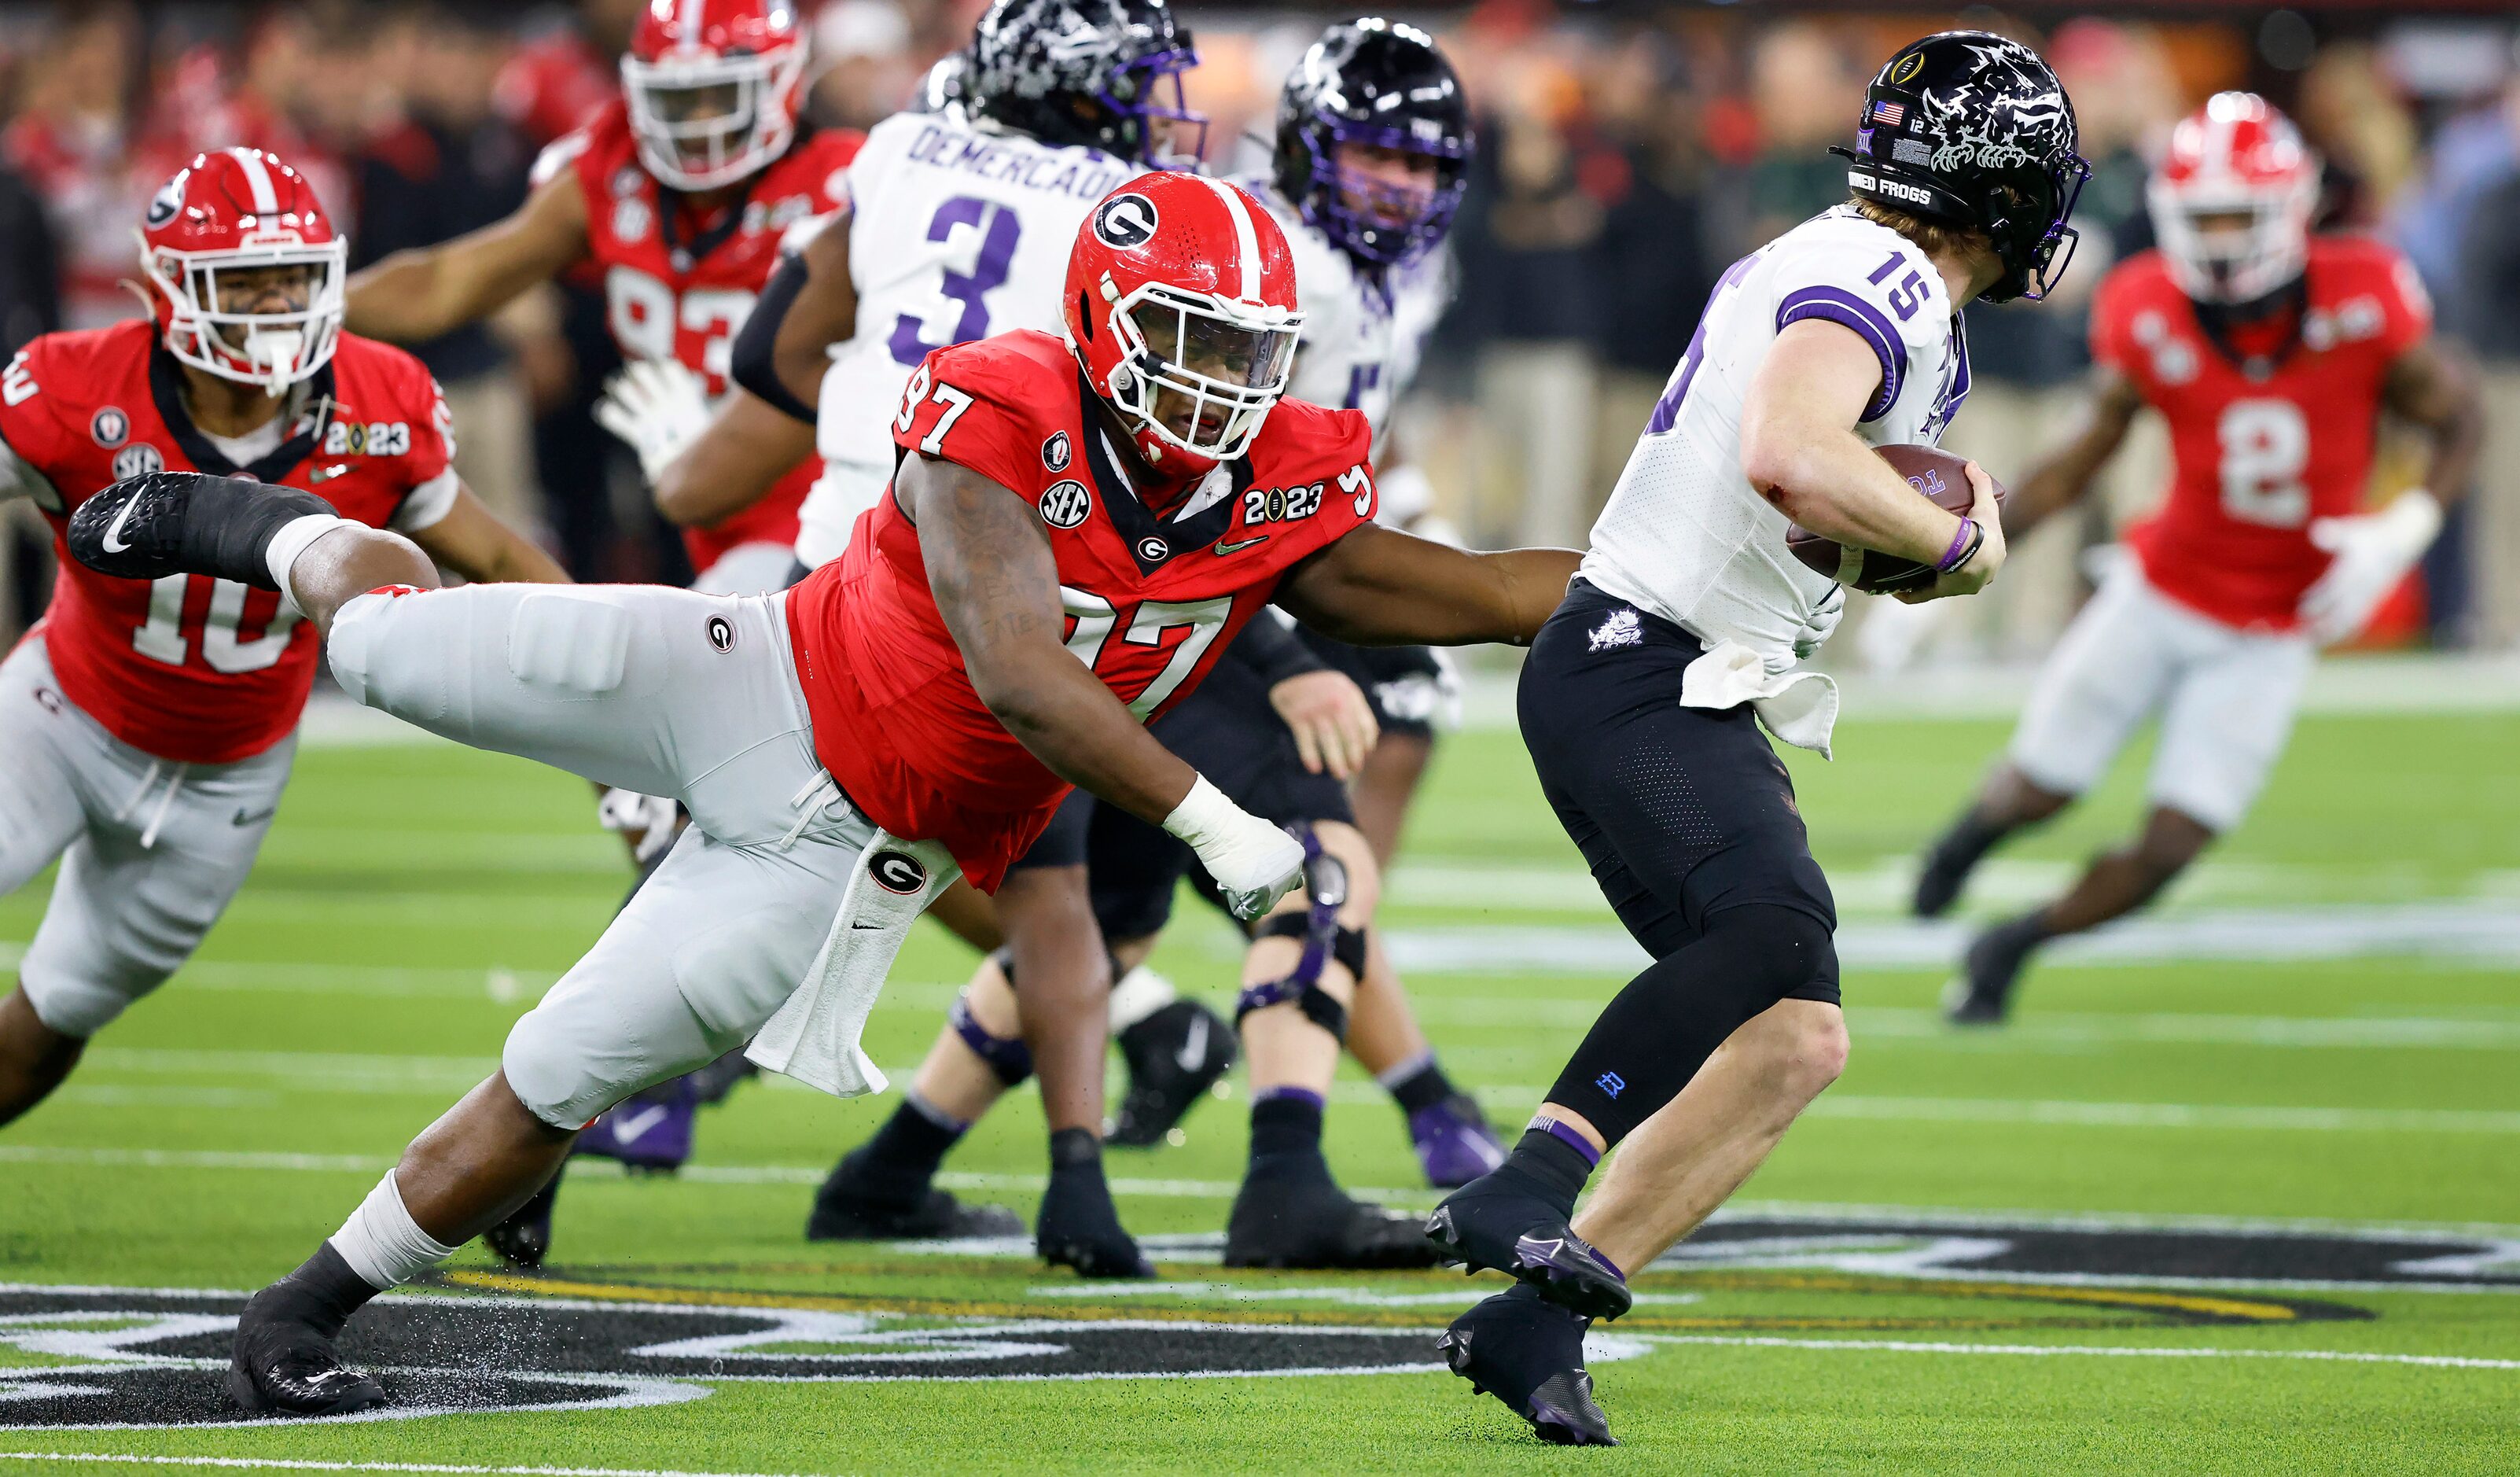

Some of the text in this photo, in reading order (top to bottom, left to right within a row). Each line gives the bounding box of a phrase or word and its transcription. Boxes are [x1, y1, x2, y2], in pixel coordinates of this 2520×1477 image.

[1909, 118, 1925, 134] 12
[1879, 179, 1932, 205] FROGS
[1094, 193, 1159, 249] G
[888, 193, 1021, 369] 3
[1867, 250, 1931, 322] 15
[896, 362, 976, 456] 97
[2217, 399, 2312, 535] 2
[1043, 483, 1087, 525] SEC
[1244, 481, 1325, 525] 2023
[1139, 537, 1168, 561] G
[707, 615, 735, 652] G
[868, 851, 925, 893] G
